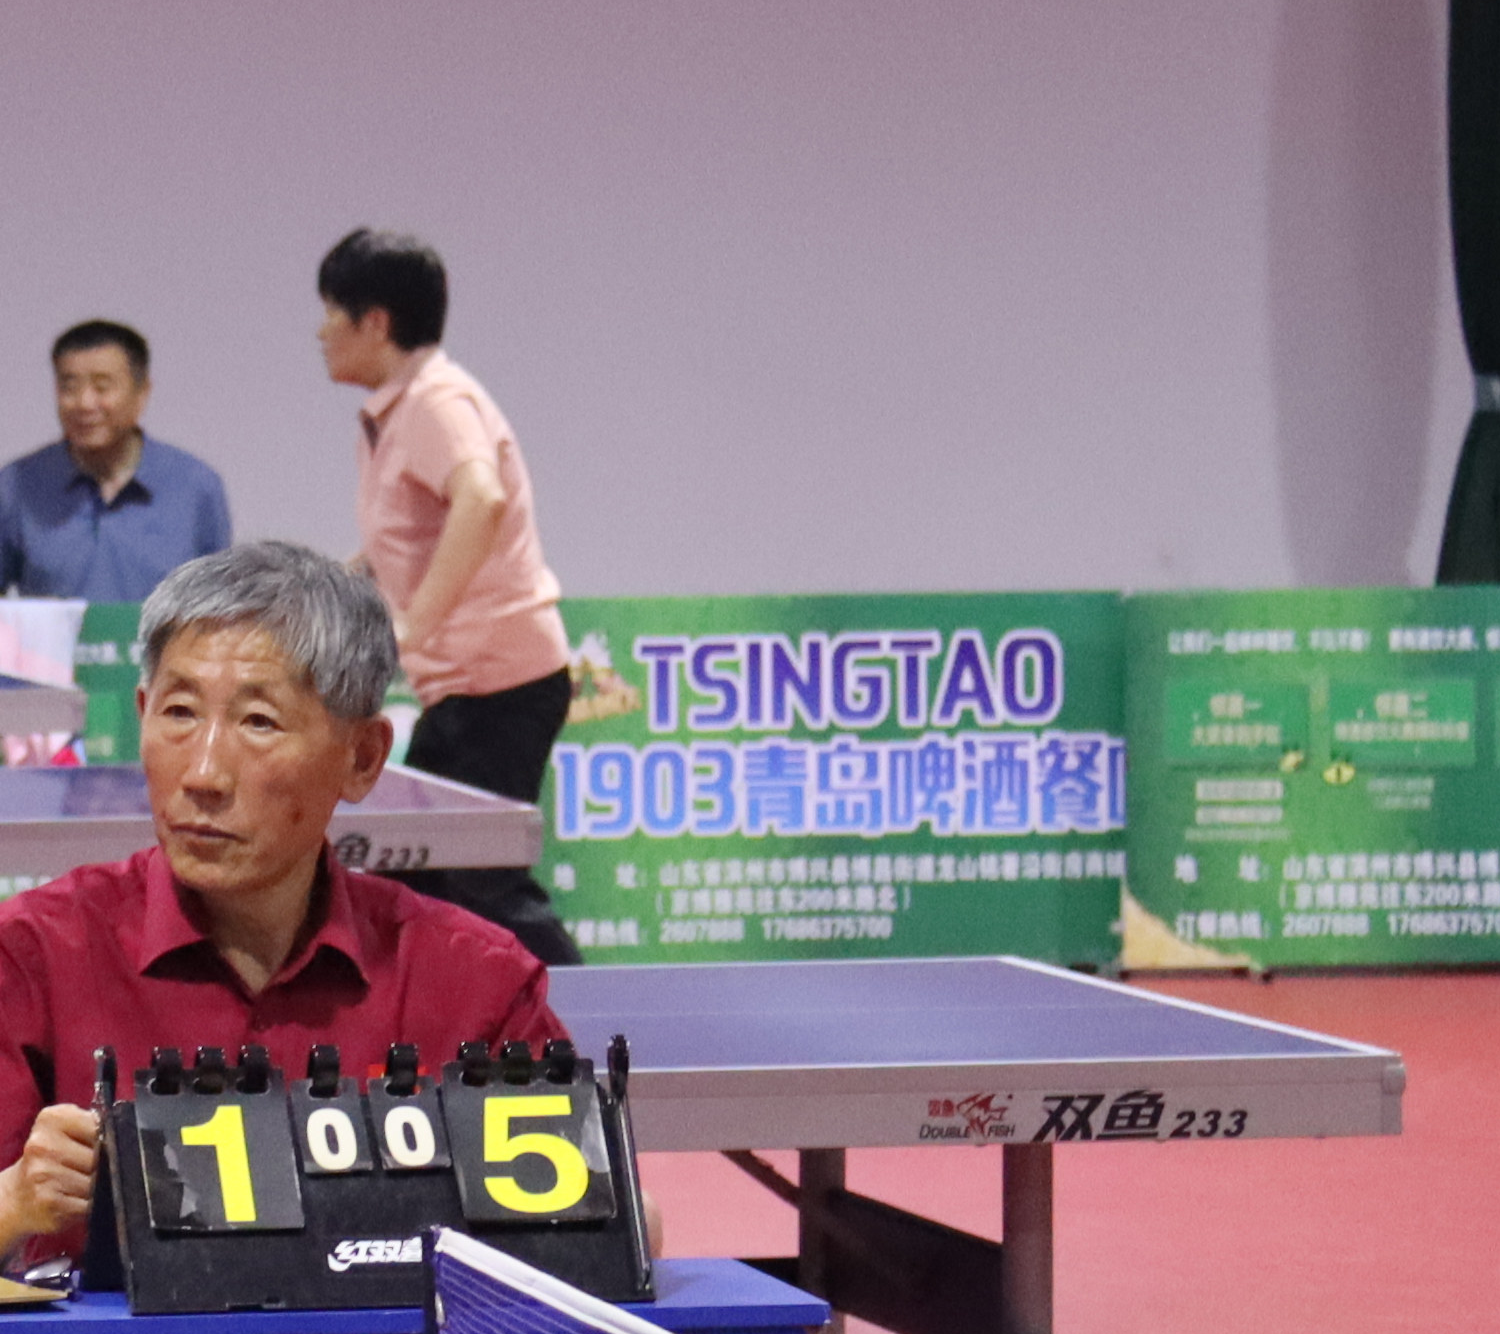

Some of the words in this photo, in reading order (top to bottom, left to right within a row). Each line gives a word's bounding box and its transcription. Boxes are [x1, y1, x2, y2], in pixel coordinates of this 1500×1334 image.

[633, 628, 1064, 733] TSINGTAO
[180, 1104, 257, 1223] 1
[482, 1093, 590, 1214] 5
[1031, 1089, 1166, 1143] 双鱼
[1168, 1109, 1250, 1138] 233
